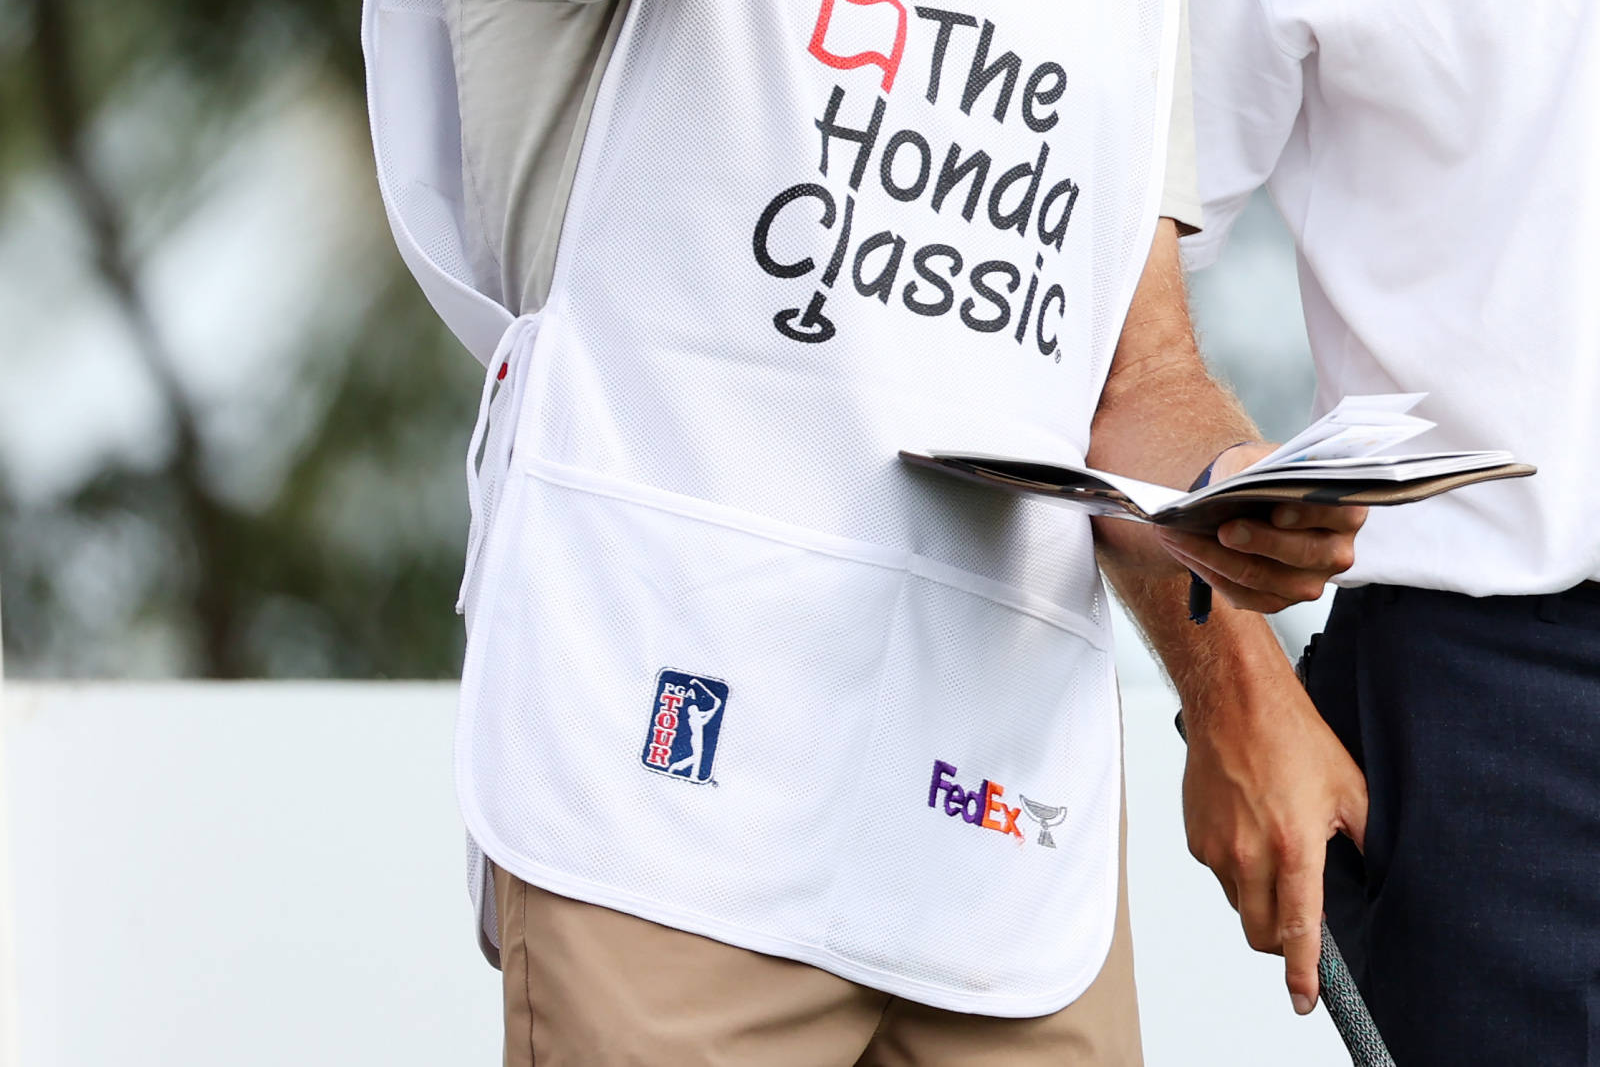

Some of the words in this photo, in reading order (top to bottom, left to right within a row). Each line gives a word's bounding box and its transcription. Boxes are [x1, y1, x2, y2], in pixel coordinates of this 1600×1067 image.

[914, 5, 1067, 133] The
[814, 84, 1080, 253] Honda
[753, 183, 1066, 356] Classic
[647, 693, 683, 768] TOUR
[664, 682, 697, 700] PGA
[928, 759, 1022, 837] FedEx
